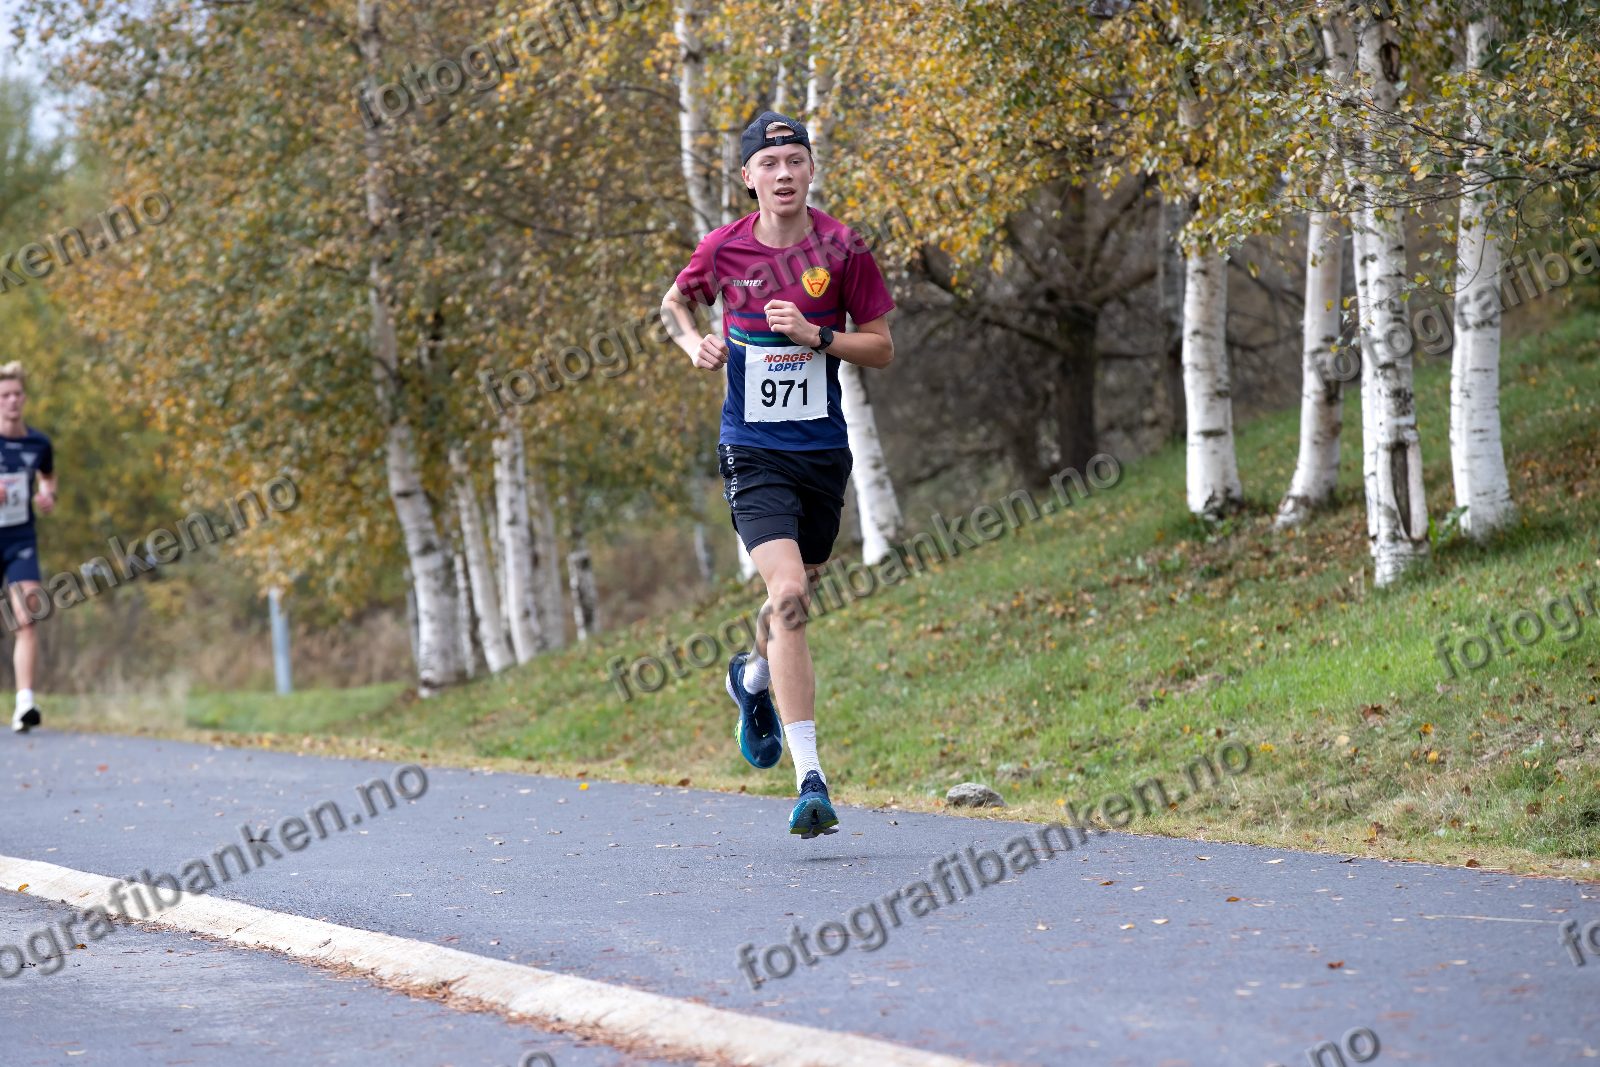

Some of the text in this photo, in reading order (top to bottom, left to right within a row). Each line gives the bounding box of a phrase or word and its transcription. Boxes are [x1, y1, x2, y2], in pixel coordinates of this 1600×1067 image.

[763, 352, 814, 363] NORGES
[767, 361, 807, 373] LØPET
[760, 378, 808, 408] 971
